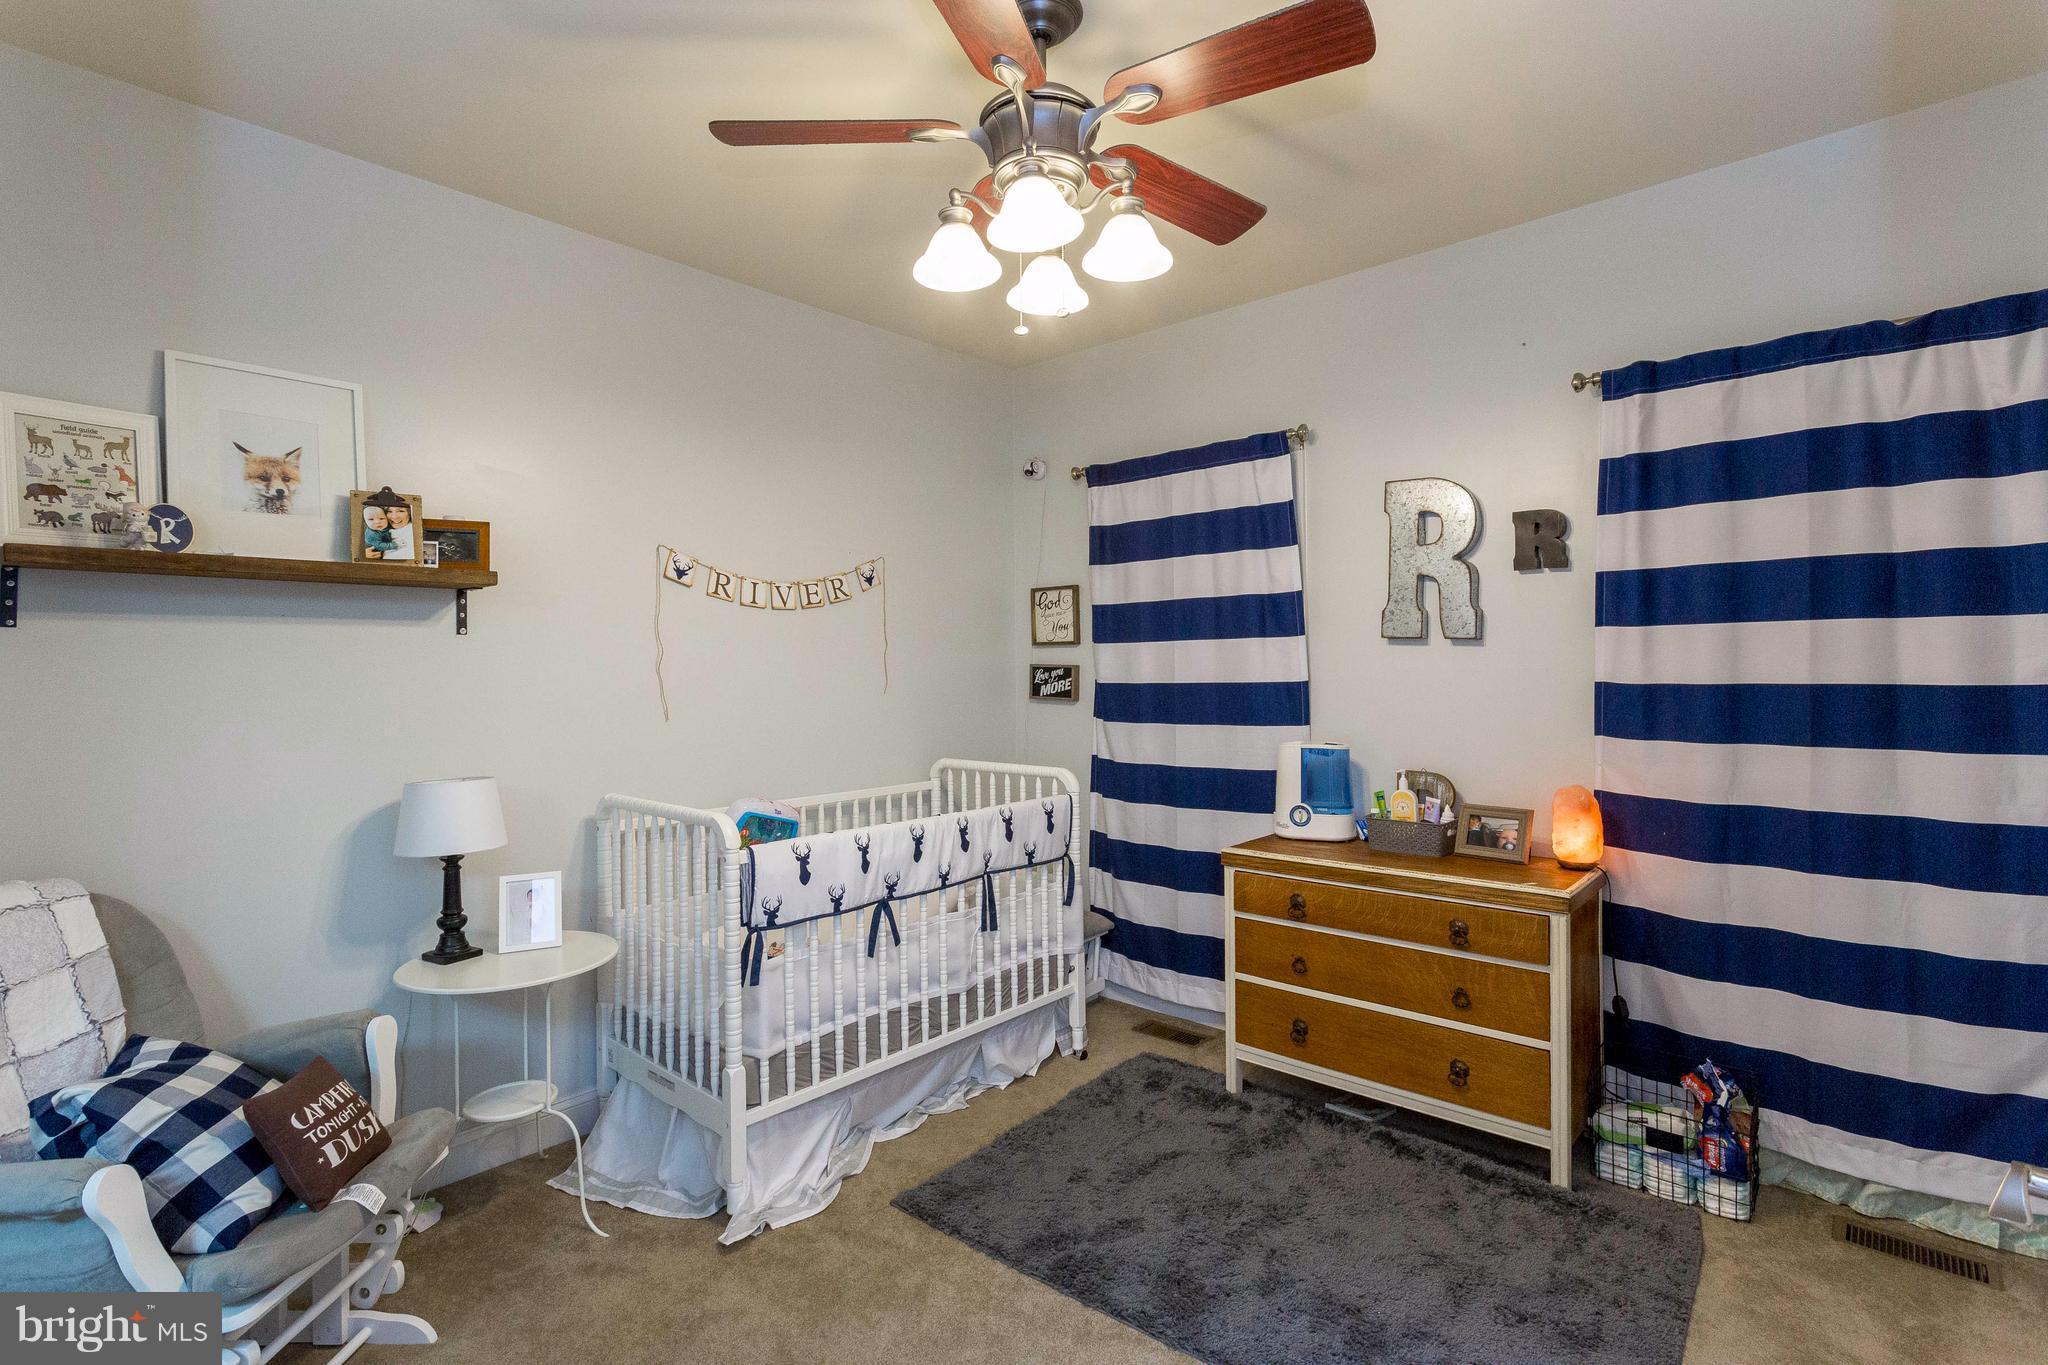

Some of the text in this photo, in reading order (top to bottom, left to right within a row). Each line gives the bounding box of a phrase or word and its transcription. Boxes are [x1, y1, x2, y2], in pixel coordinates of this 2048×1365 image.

[160, 517, 181, 544] R
[1512, 509, 1569, 571] R
[1381, 477, 1483, 640] R
[713, 571, 850, 608] RIVER
[1036, 591, 1072, 612] God
[1034, 669, 1050, 684] Love
[1040, 678, 1072, 696] MORE
[291, 1078, 357, 1129] CAMPFIR
[303, 1102, 358, 1143] TONIGHT
